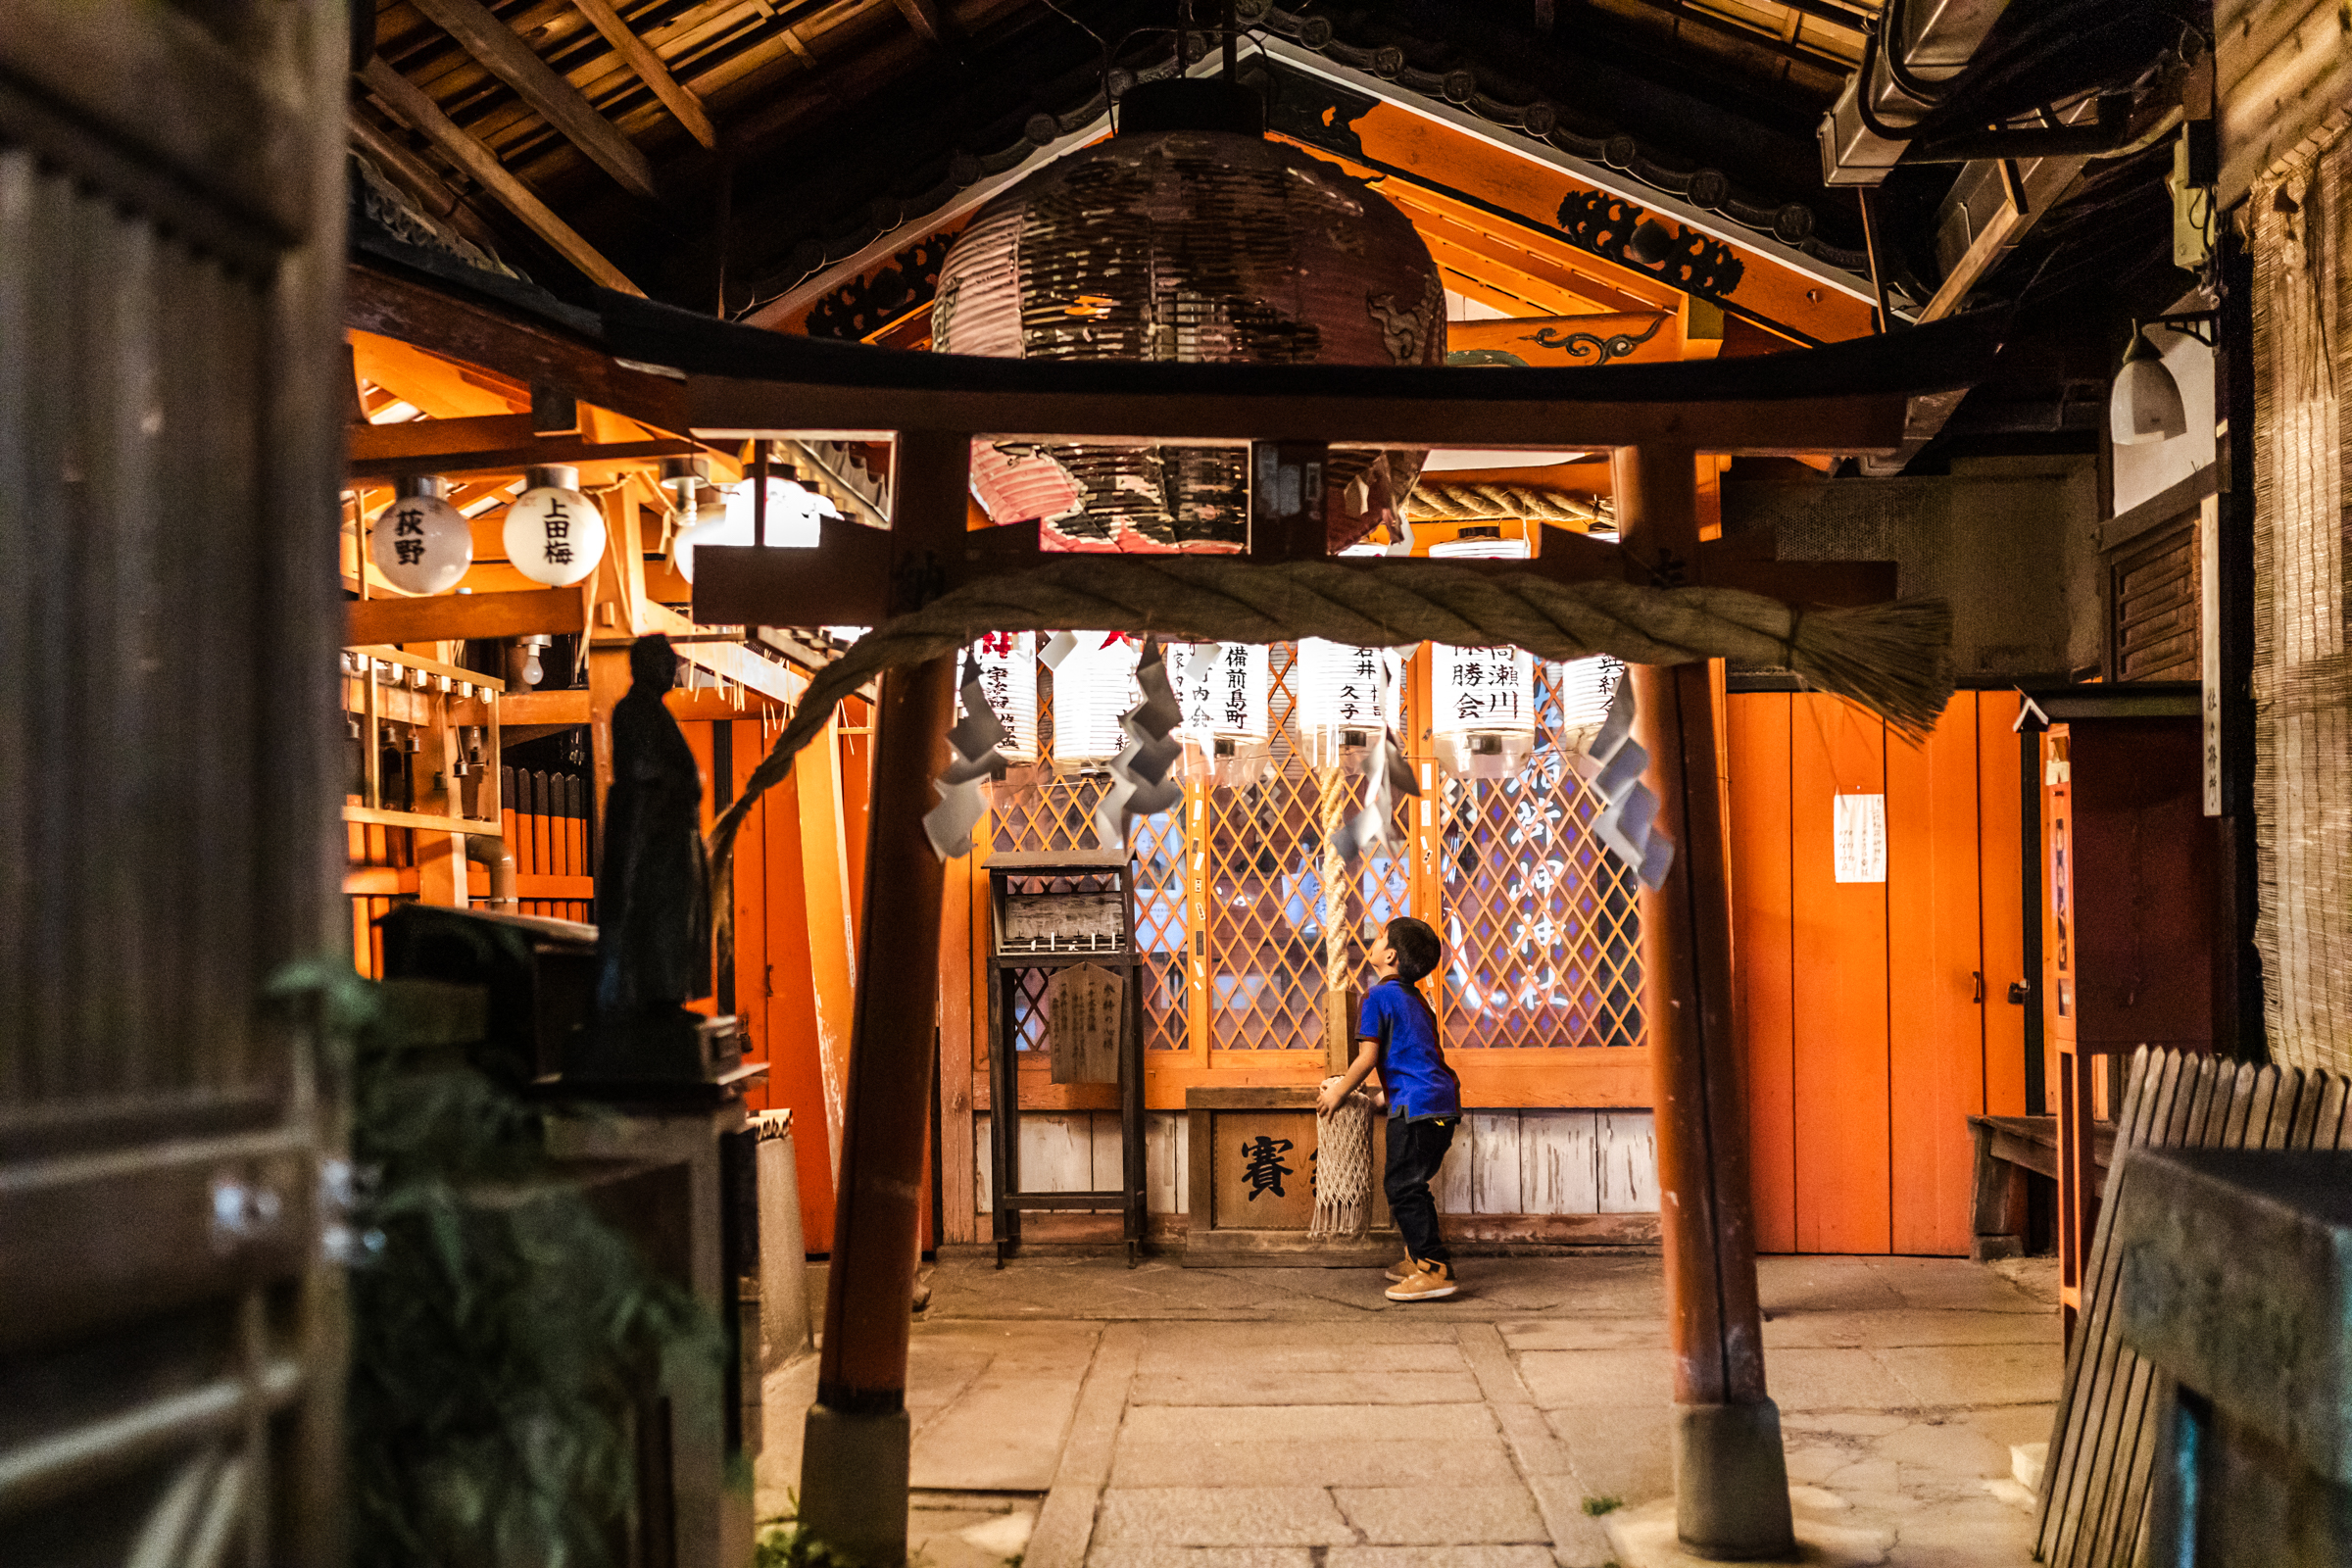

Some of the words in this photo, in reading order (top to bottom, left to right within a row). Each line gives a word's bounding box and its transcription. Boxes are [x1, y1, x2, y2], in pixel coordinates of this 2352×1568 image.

[1225, 645, 1249, 729] 備前島町
[1340, 684, 1360, 720] 久子
[1505, 652, 1575, 1013] 稲荷岬神社
[1242, 1136, 1318, 1202] 賽
